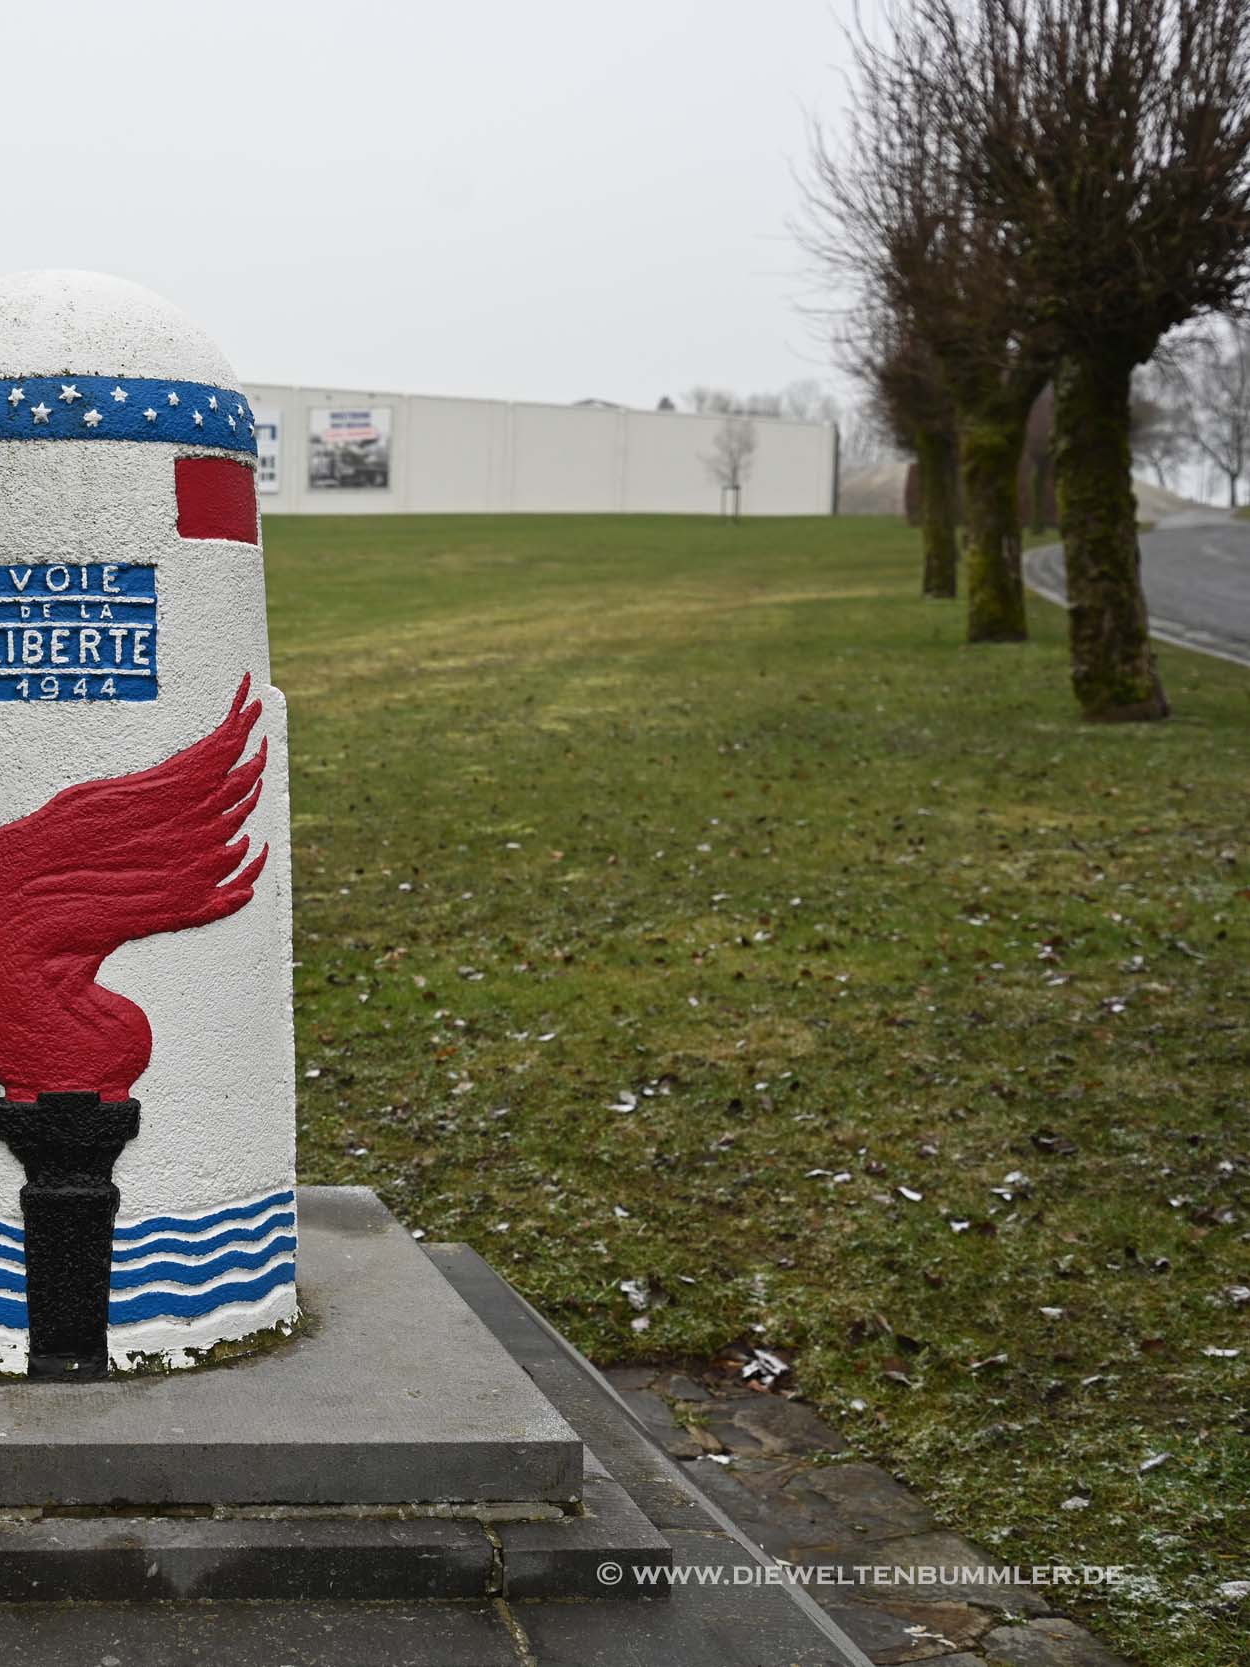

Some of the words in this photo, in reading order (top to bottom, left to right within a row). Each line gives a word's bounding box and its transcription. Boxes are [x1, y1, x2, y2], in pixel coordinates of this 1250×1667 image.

[9, 565, 121, 593] VOIE
[20, 603, 51, 618] DE
[80, 603, 114, 619] LA
[16, 676, 117, 699] 1944
